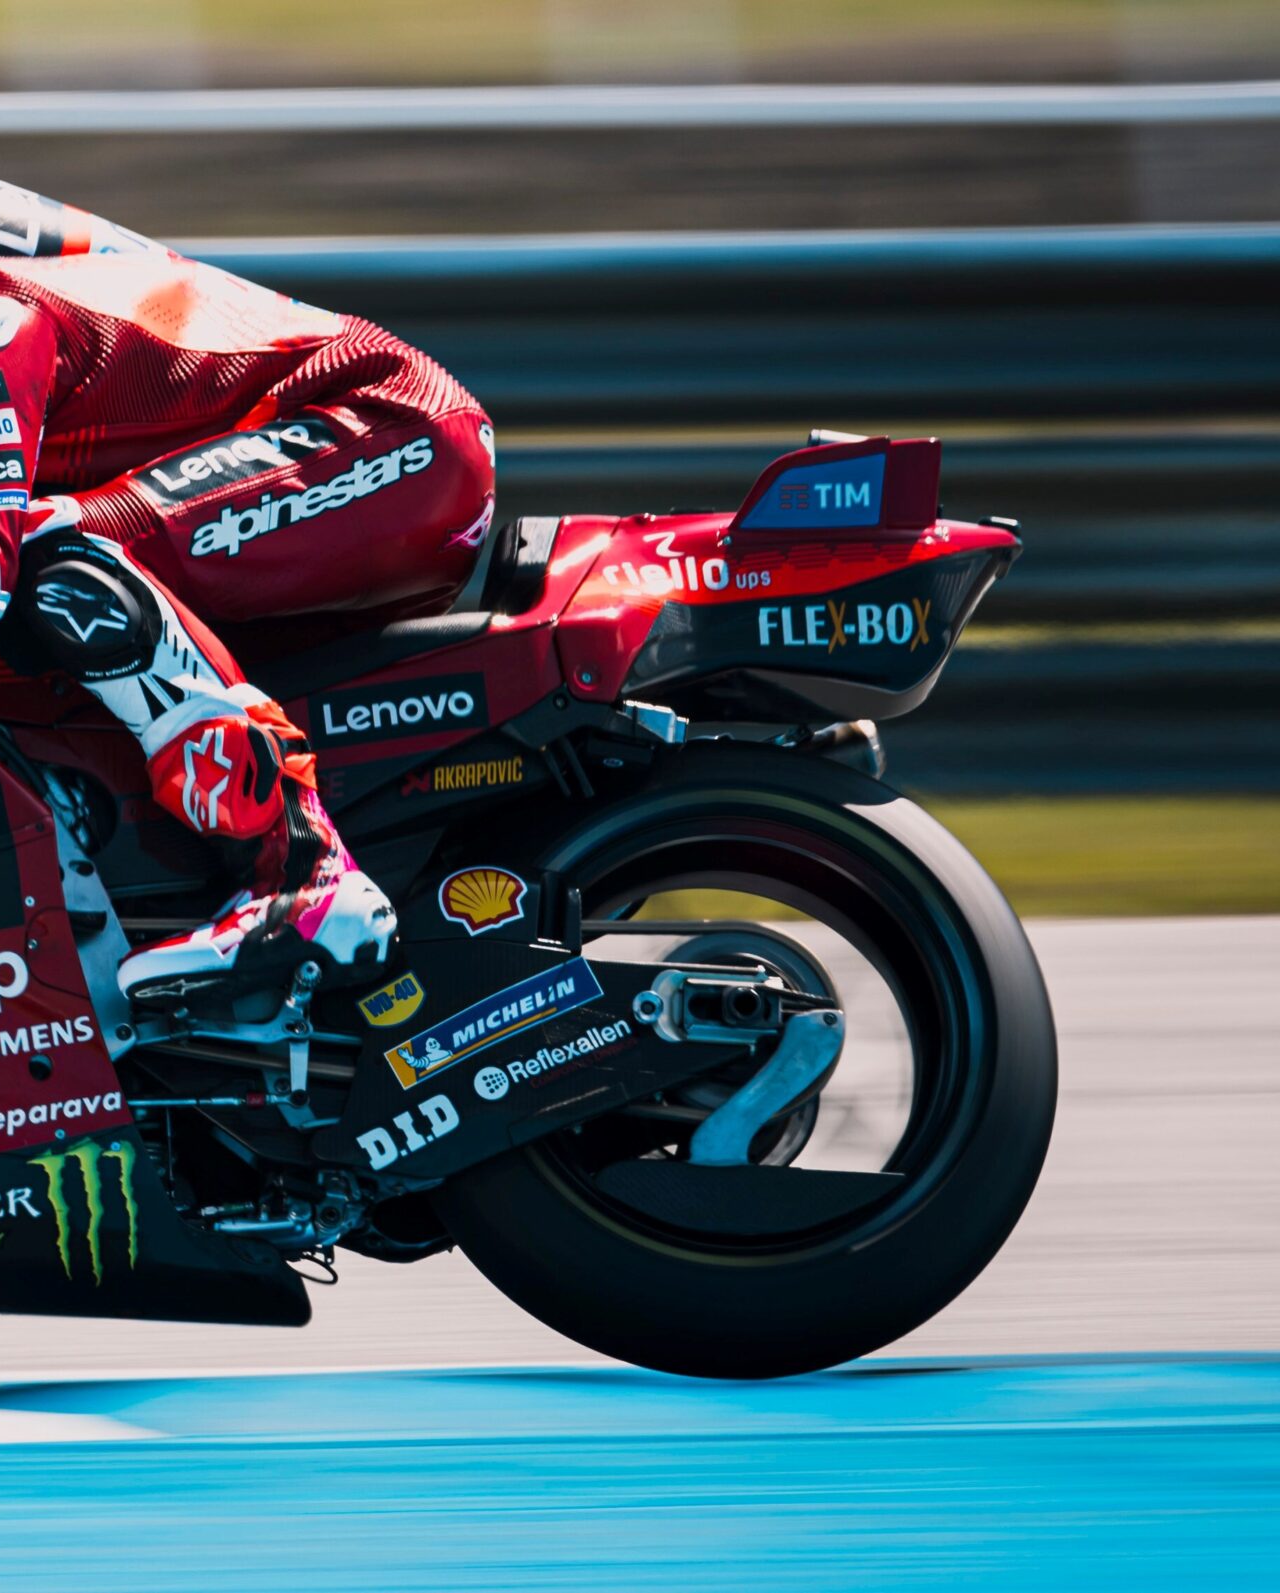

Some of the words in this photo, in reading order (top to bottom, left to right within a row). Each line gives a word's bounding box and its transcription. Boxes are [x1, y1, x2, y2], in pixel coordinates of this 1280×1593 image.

[150, 424, 318, 494] Lenovo
[190, 437, 435, 558] alpinestars
[814, 482, 870, 508] TIM
[602, 556, 729, 596] riello
[758, 597, 930, 654] FLEX-BOX
[322, 691, 474, 735] Lenovo
[362, 978, 418, 1019] WD-40
[452, 977, 575, 1049] MICHELIN
[507, 1018, 631, 1084] Reflexallen
